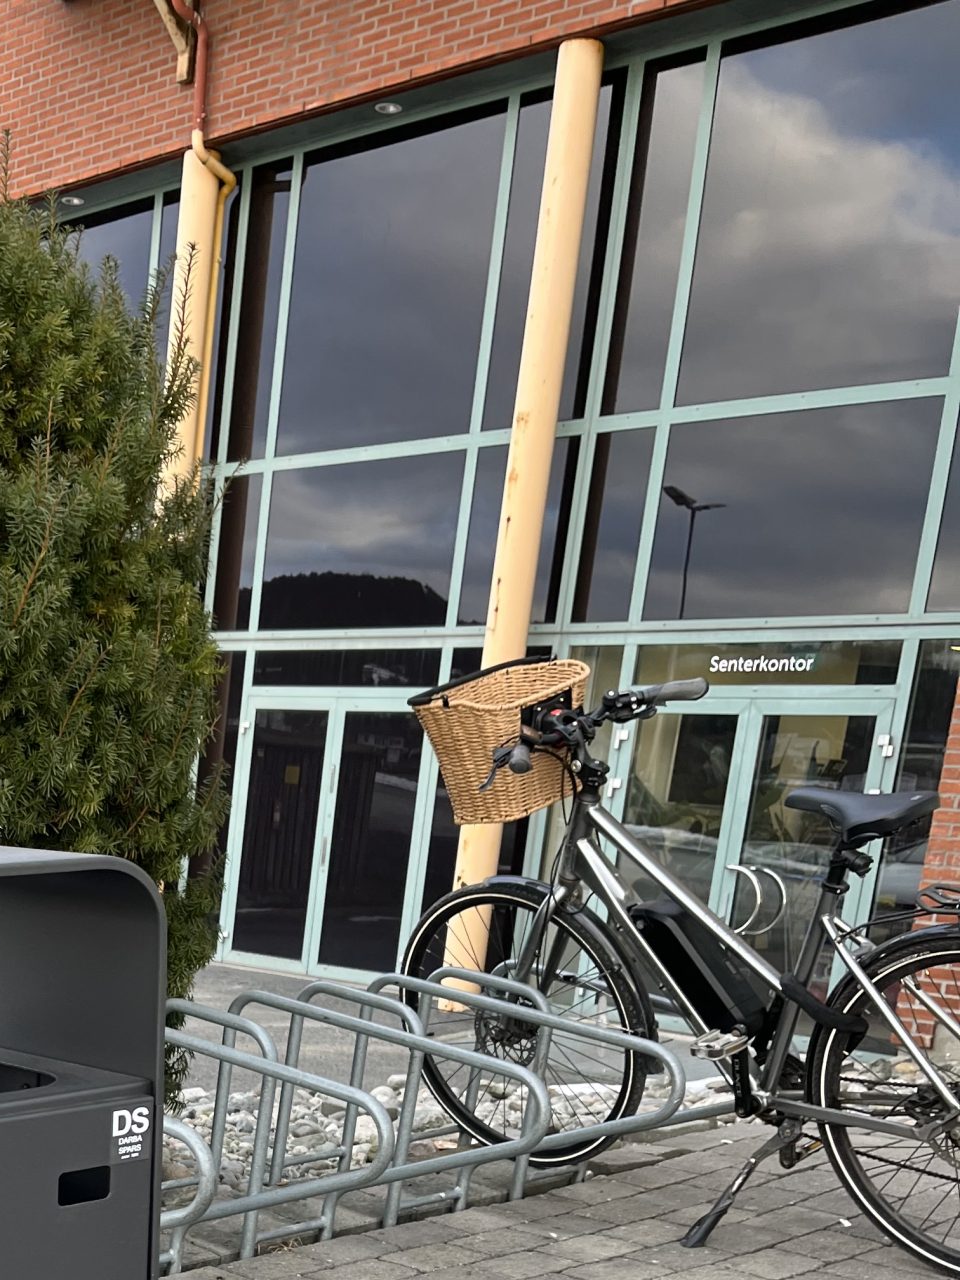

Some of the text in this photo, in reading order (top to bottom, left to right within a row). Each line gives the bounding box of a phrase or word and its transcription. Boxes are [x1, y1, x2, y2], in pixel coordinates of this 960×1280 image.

[709, 655, 814, 673] Senterkontor
[112, 1107, 149, 1137] DS
[118, 1135, 142, 1145] DARBA
[118, 1144, 141, 1154] SPARS
